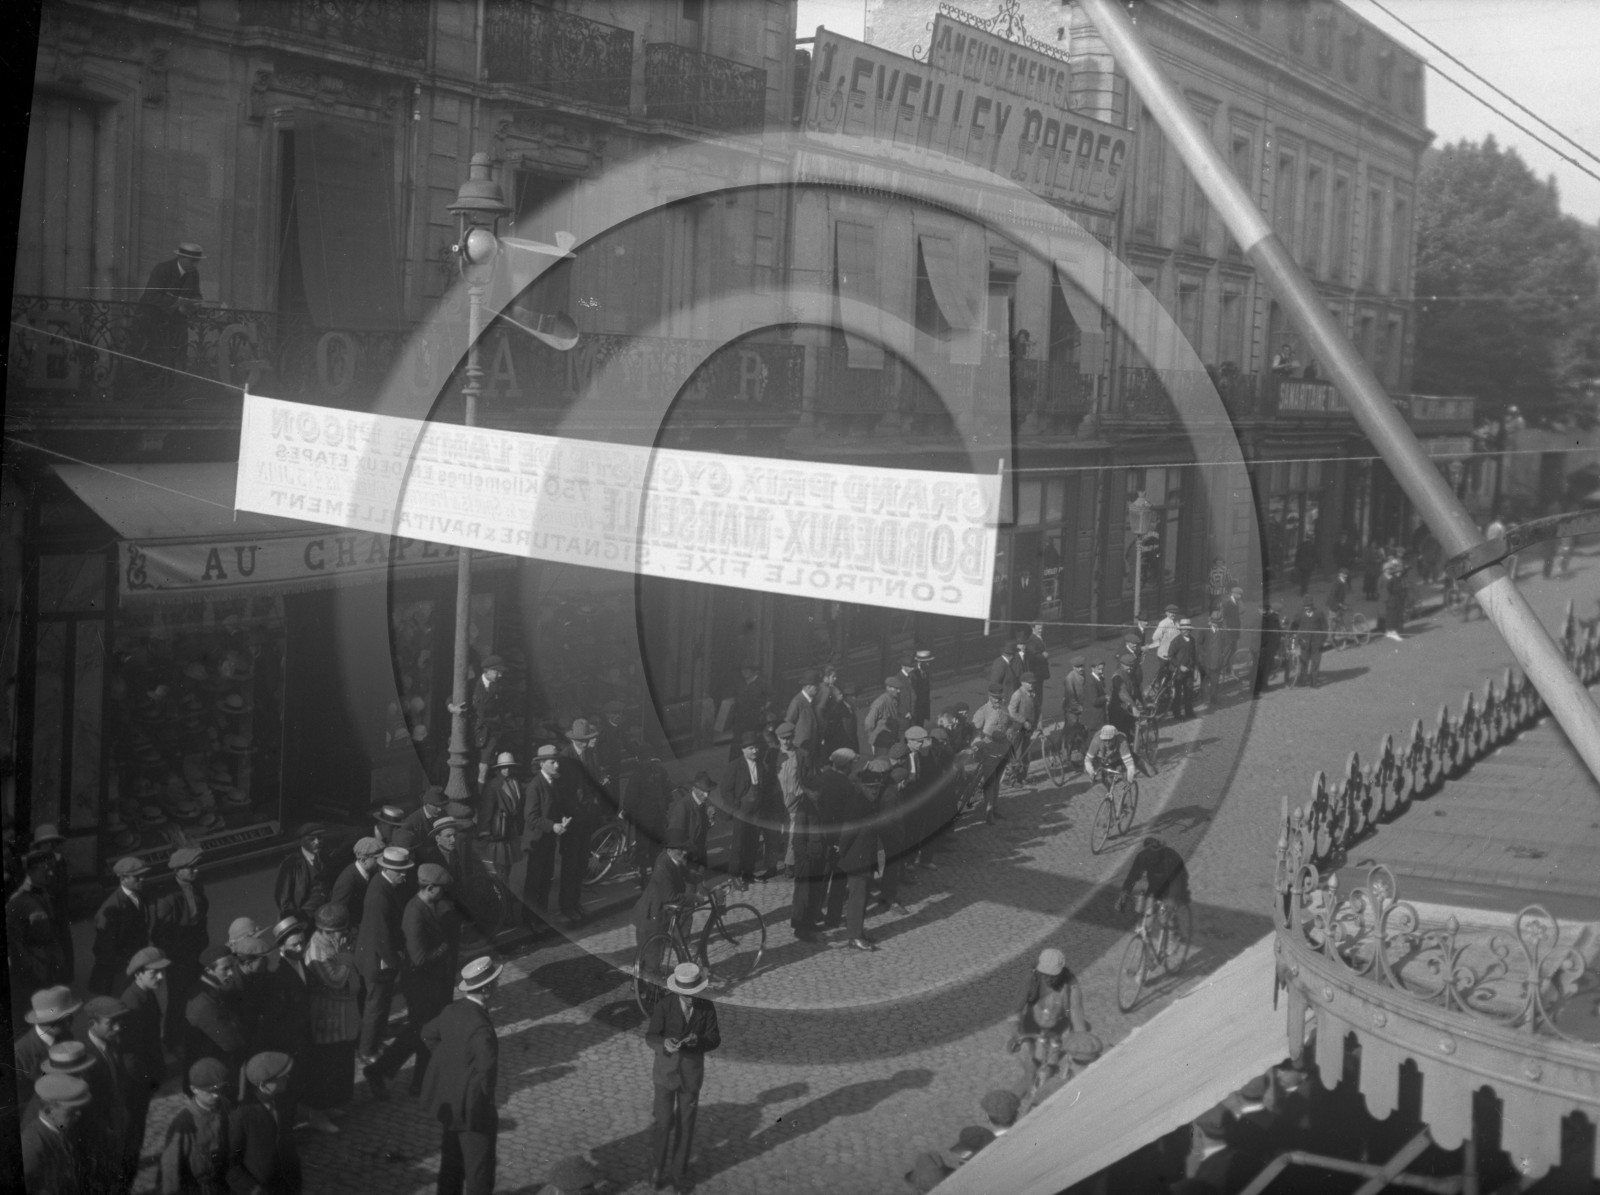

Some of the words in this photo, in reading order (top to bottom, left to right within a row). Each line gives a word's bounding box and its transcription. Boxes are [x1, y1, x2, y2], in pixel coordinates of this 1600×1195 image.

[935, 24, 1066, 107] AMEUBLEMENTS
[1010, 107, 1126, 201] FRERES
[201, 544, 259, 581] AU
